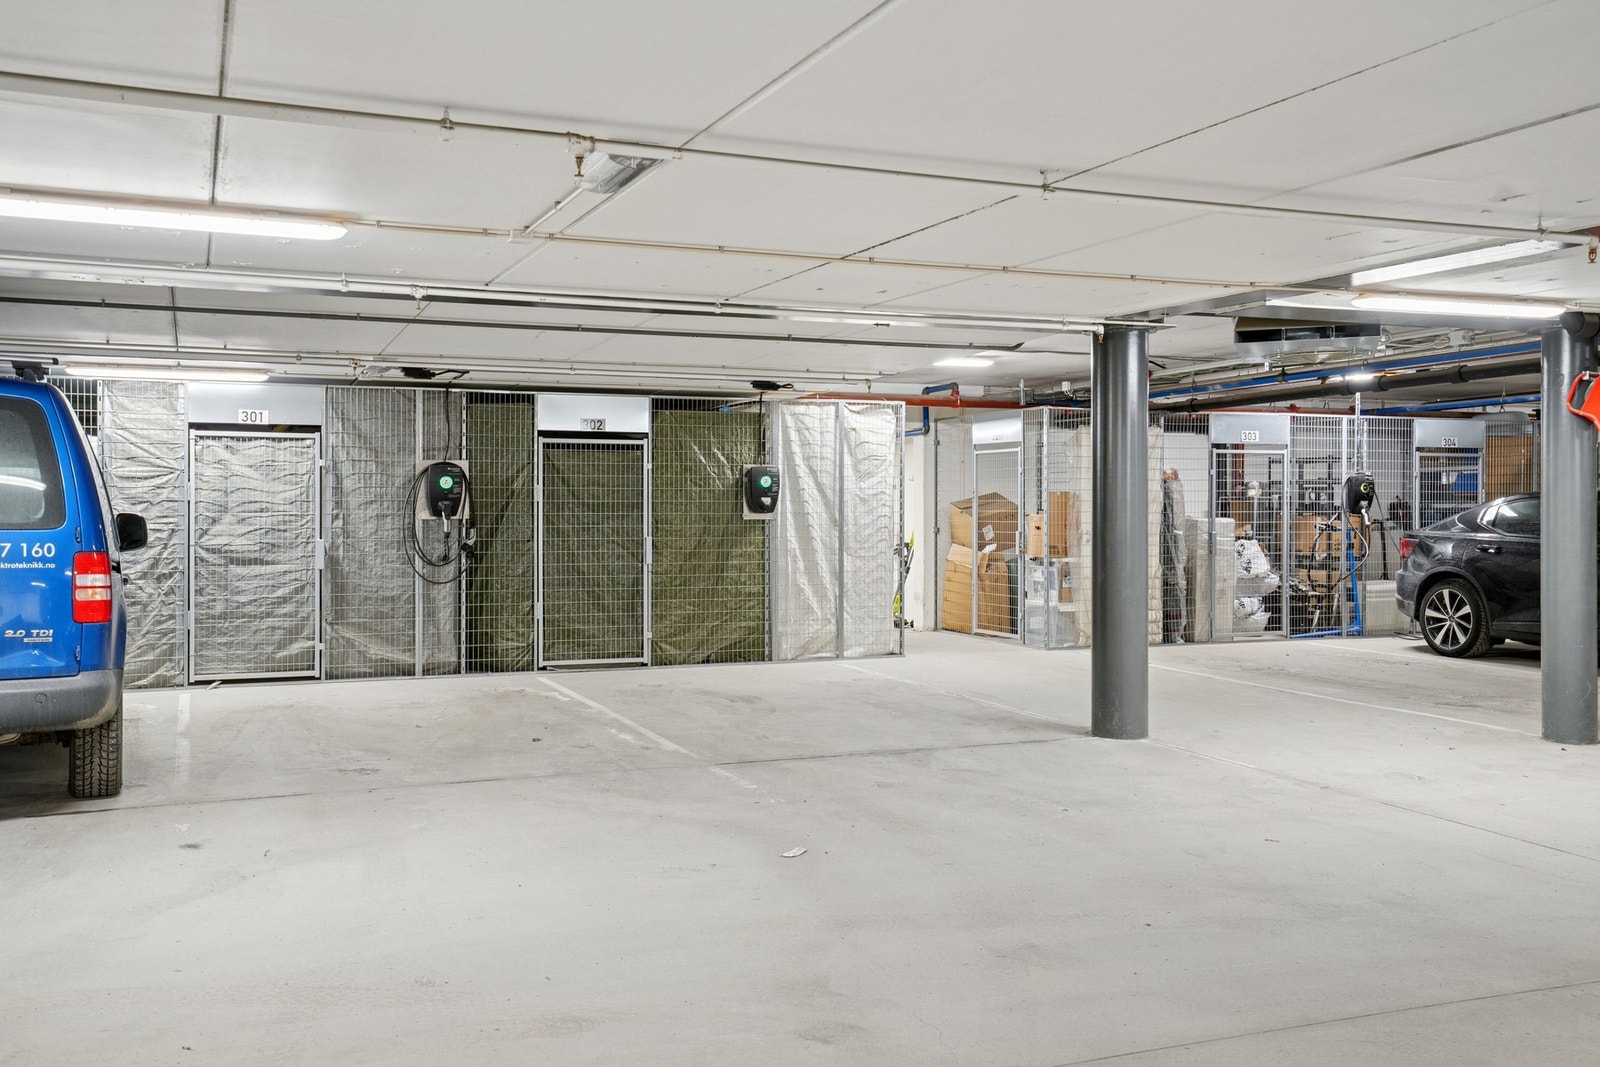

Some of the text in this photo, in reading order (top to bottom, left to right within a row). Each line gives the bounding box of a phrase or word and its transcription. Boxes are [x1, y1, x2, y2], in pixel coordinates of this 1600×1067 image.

[241, 410, 263, 423] 301
[582, 419, 603, 431] 302
[1242, 431, 1257, 441] 303
[1442, 438, 1456, 447] 304
[0, 542, 56, 558] 7 160
[0, 561, 56, 569] ktroteknikk.no
[30, 629, 54, 637] TDI
